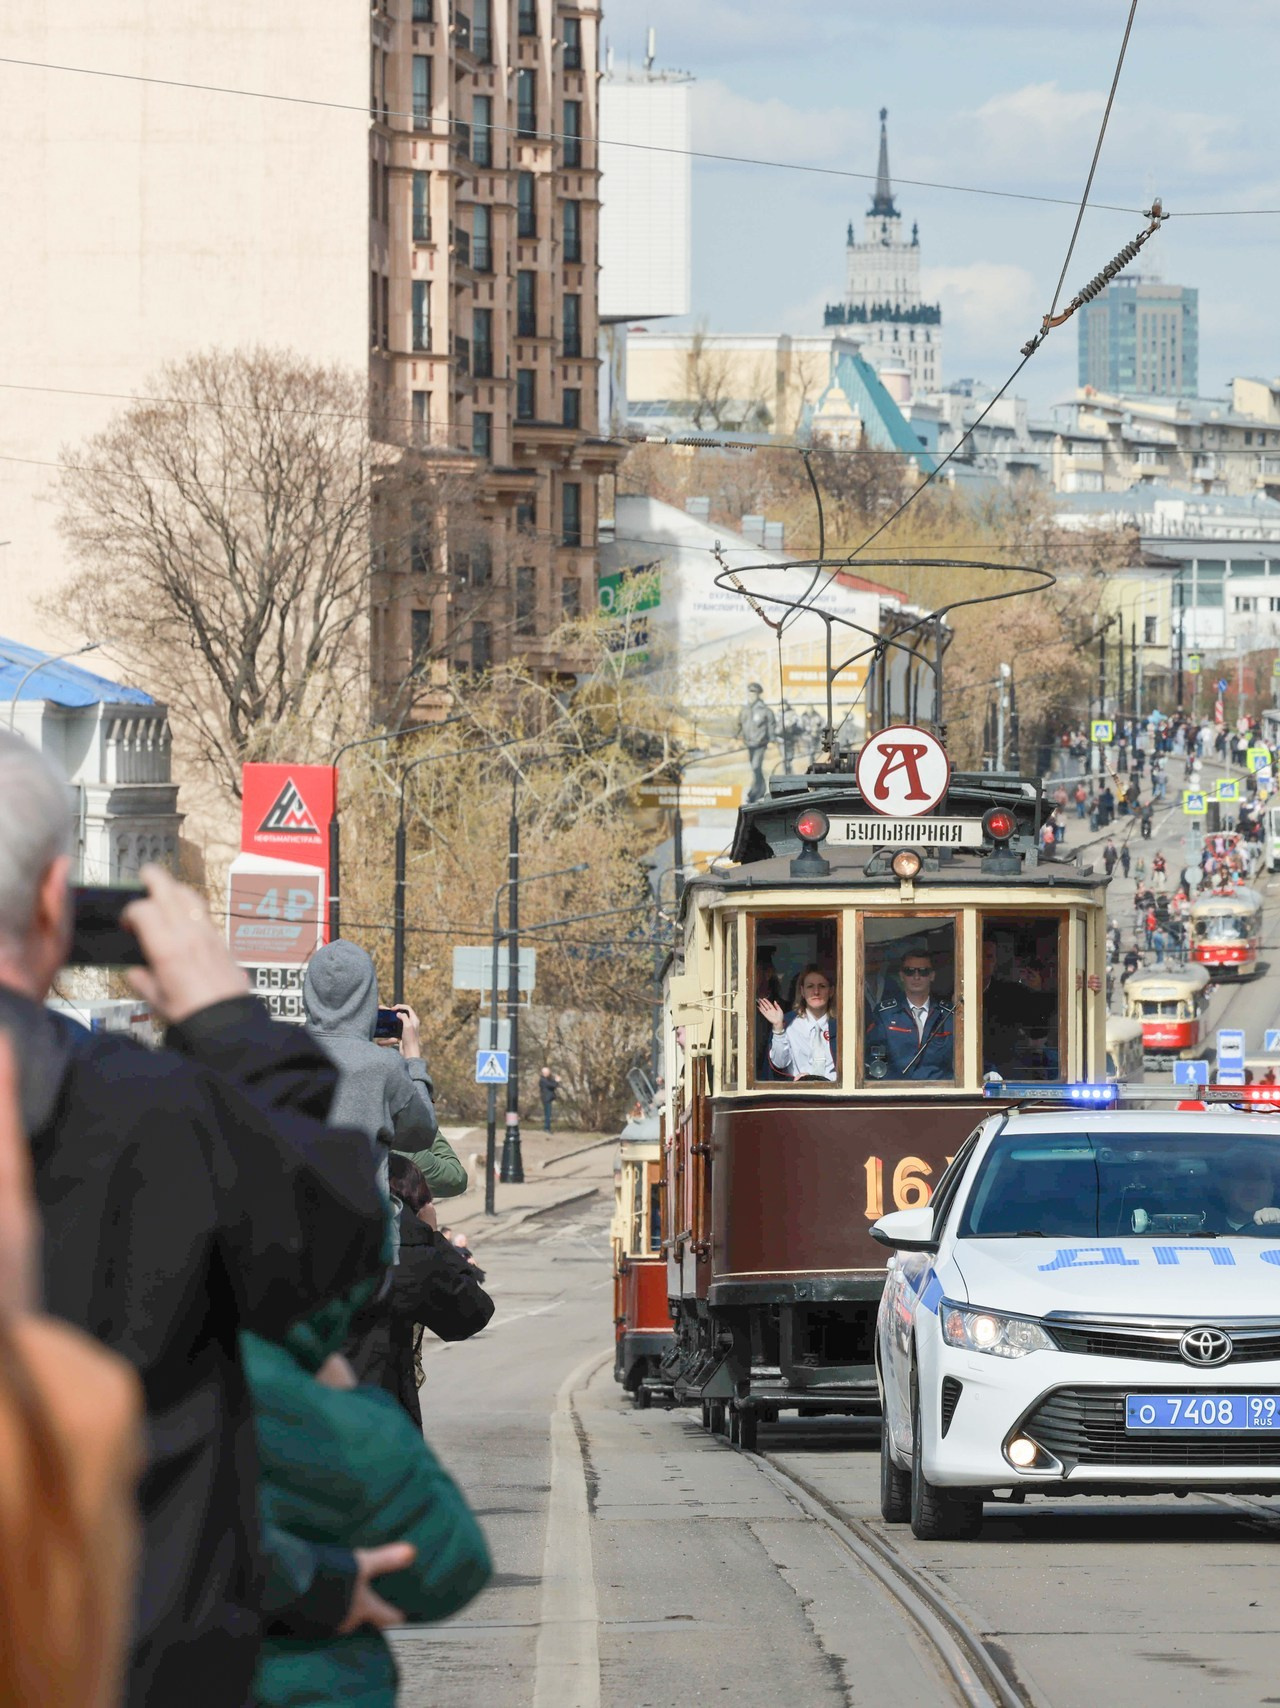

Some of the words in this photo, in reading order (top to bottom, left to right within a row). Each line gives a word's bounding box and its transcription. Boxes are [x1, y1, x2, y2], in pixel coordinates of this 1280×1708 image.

[874, 744, 931, 800] А
[845, 822, 963, 843] БУЛЬВАРНАЯ
[256, 995, 306, 1017] 9.9
[863, 1155, 954, 1220] 16
[1167, 1399, 1234, 1425] 7408
[1250, 1398, 1276, 1418] 99
[1253, 1418, 1273, 1426] RUS
